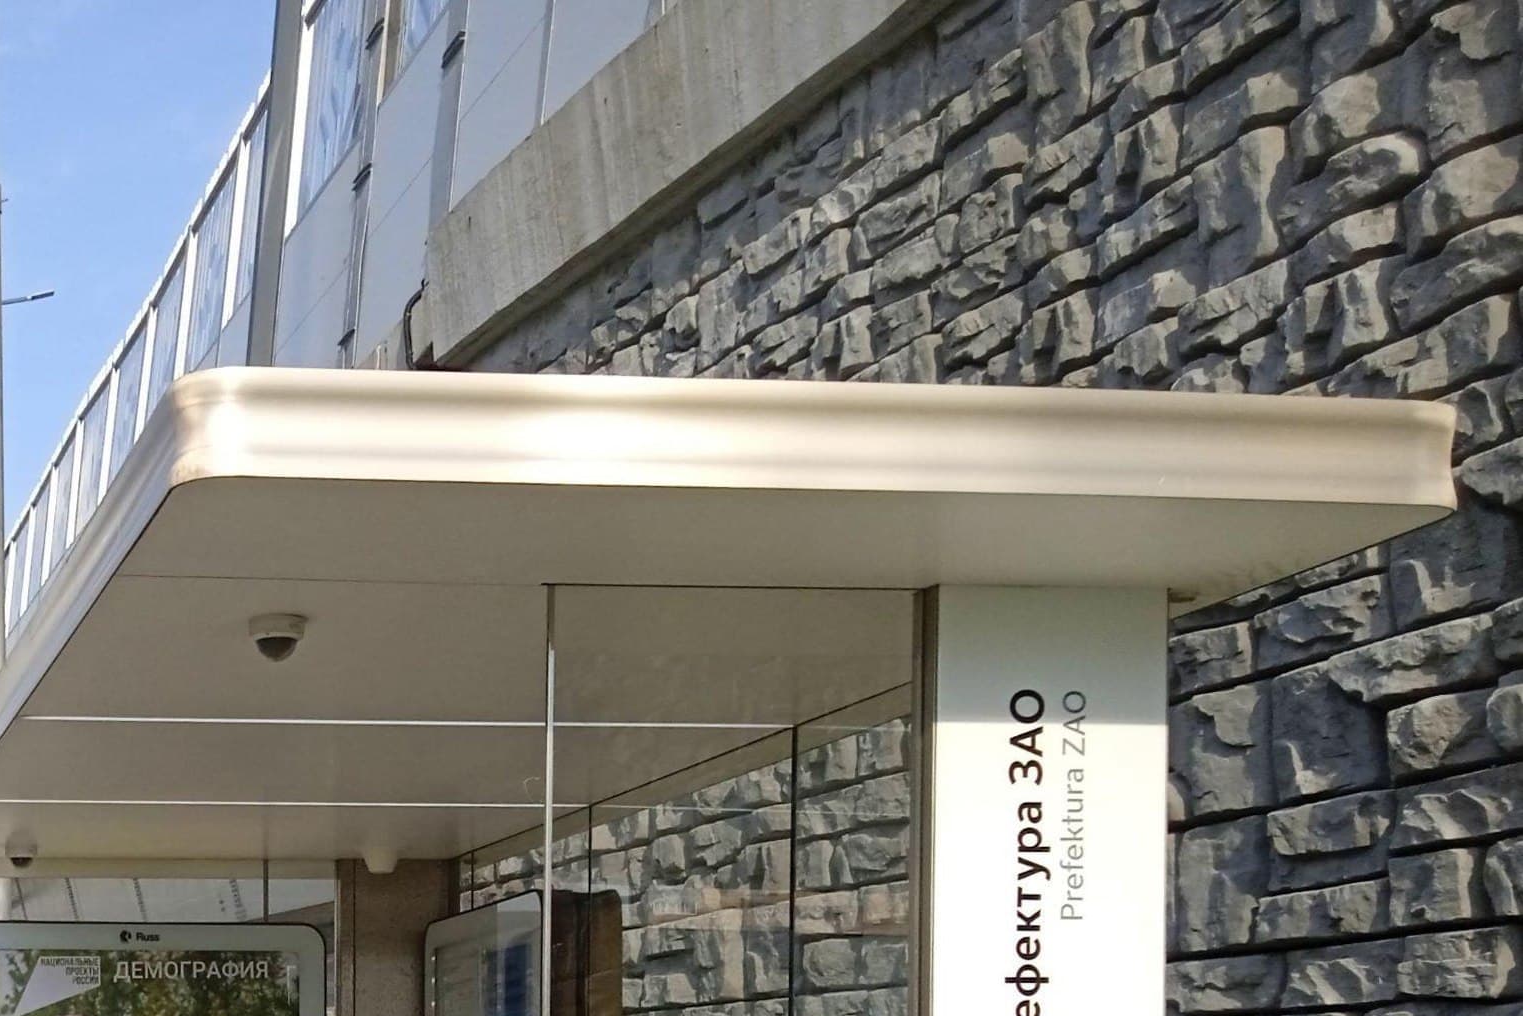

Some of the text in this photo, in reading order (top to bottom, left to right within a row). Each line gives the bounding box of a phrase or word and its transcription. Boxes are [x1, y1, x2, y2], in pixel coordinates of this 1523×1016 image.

[1008, 688, 1046, 785] ЗАО
[1060, 690, 1087, 920] Prefektura ZAO
[114, 961, 269, 982] ДЕМОГРАФИЯ
